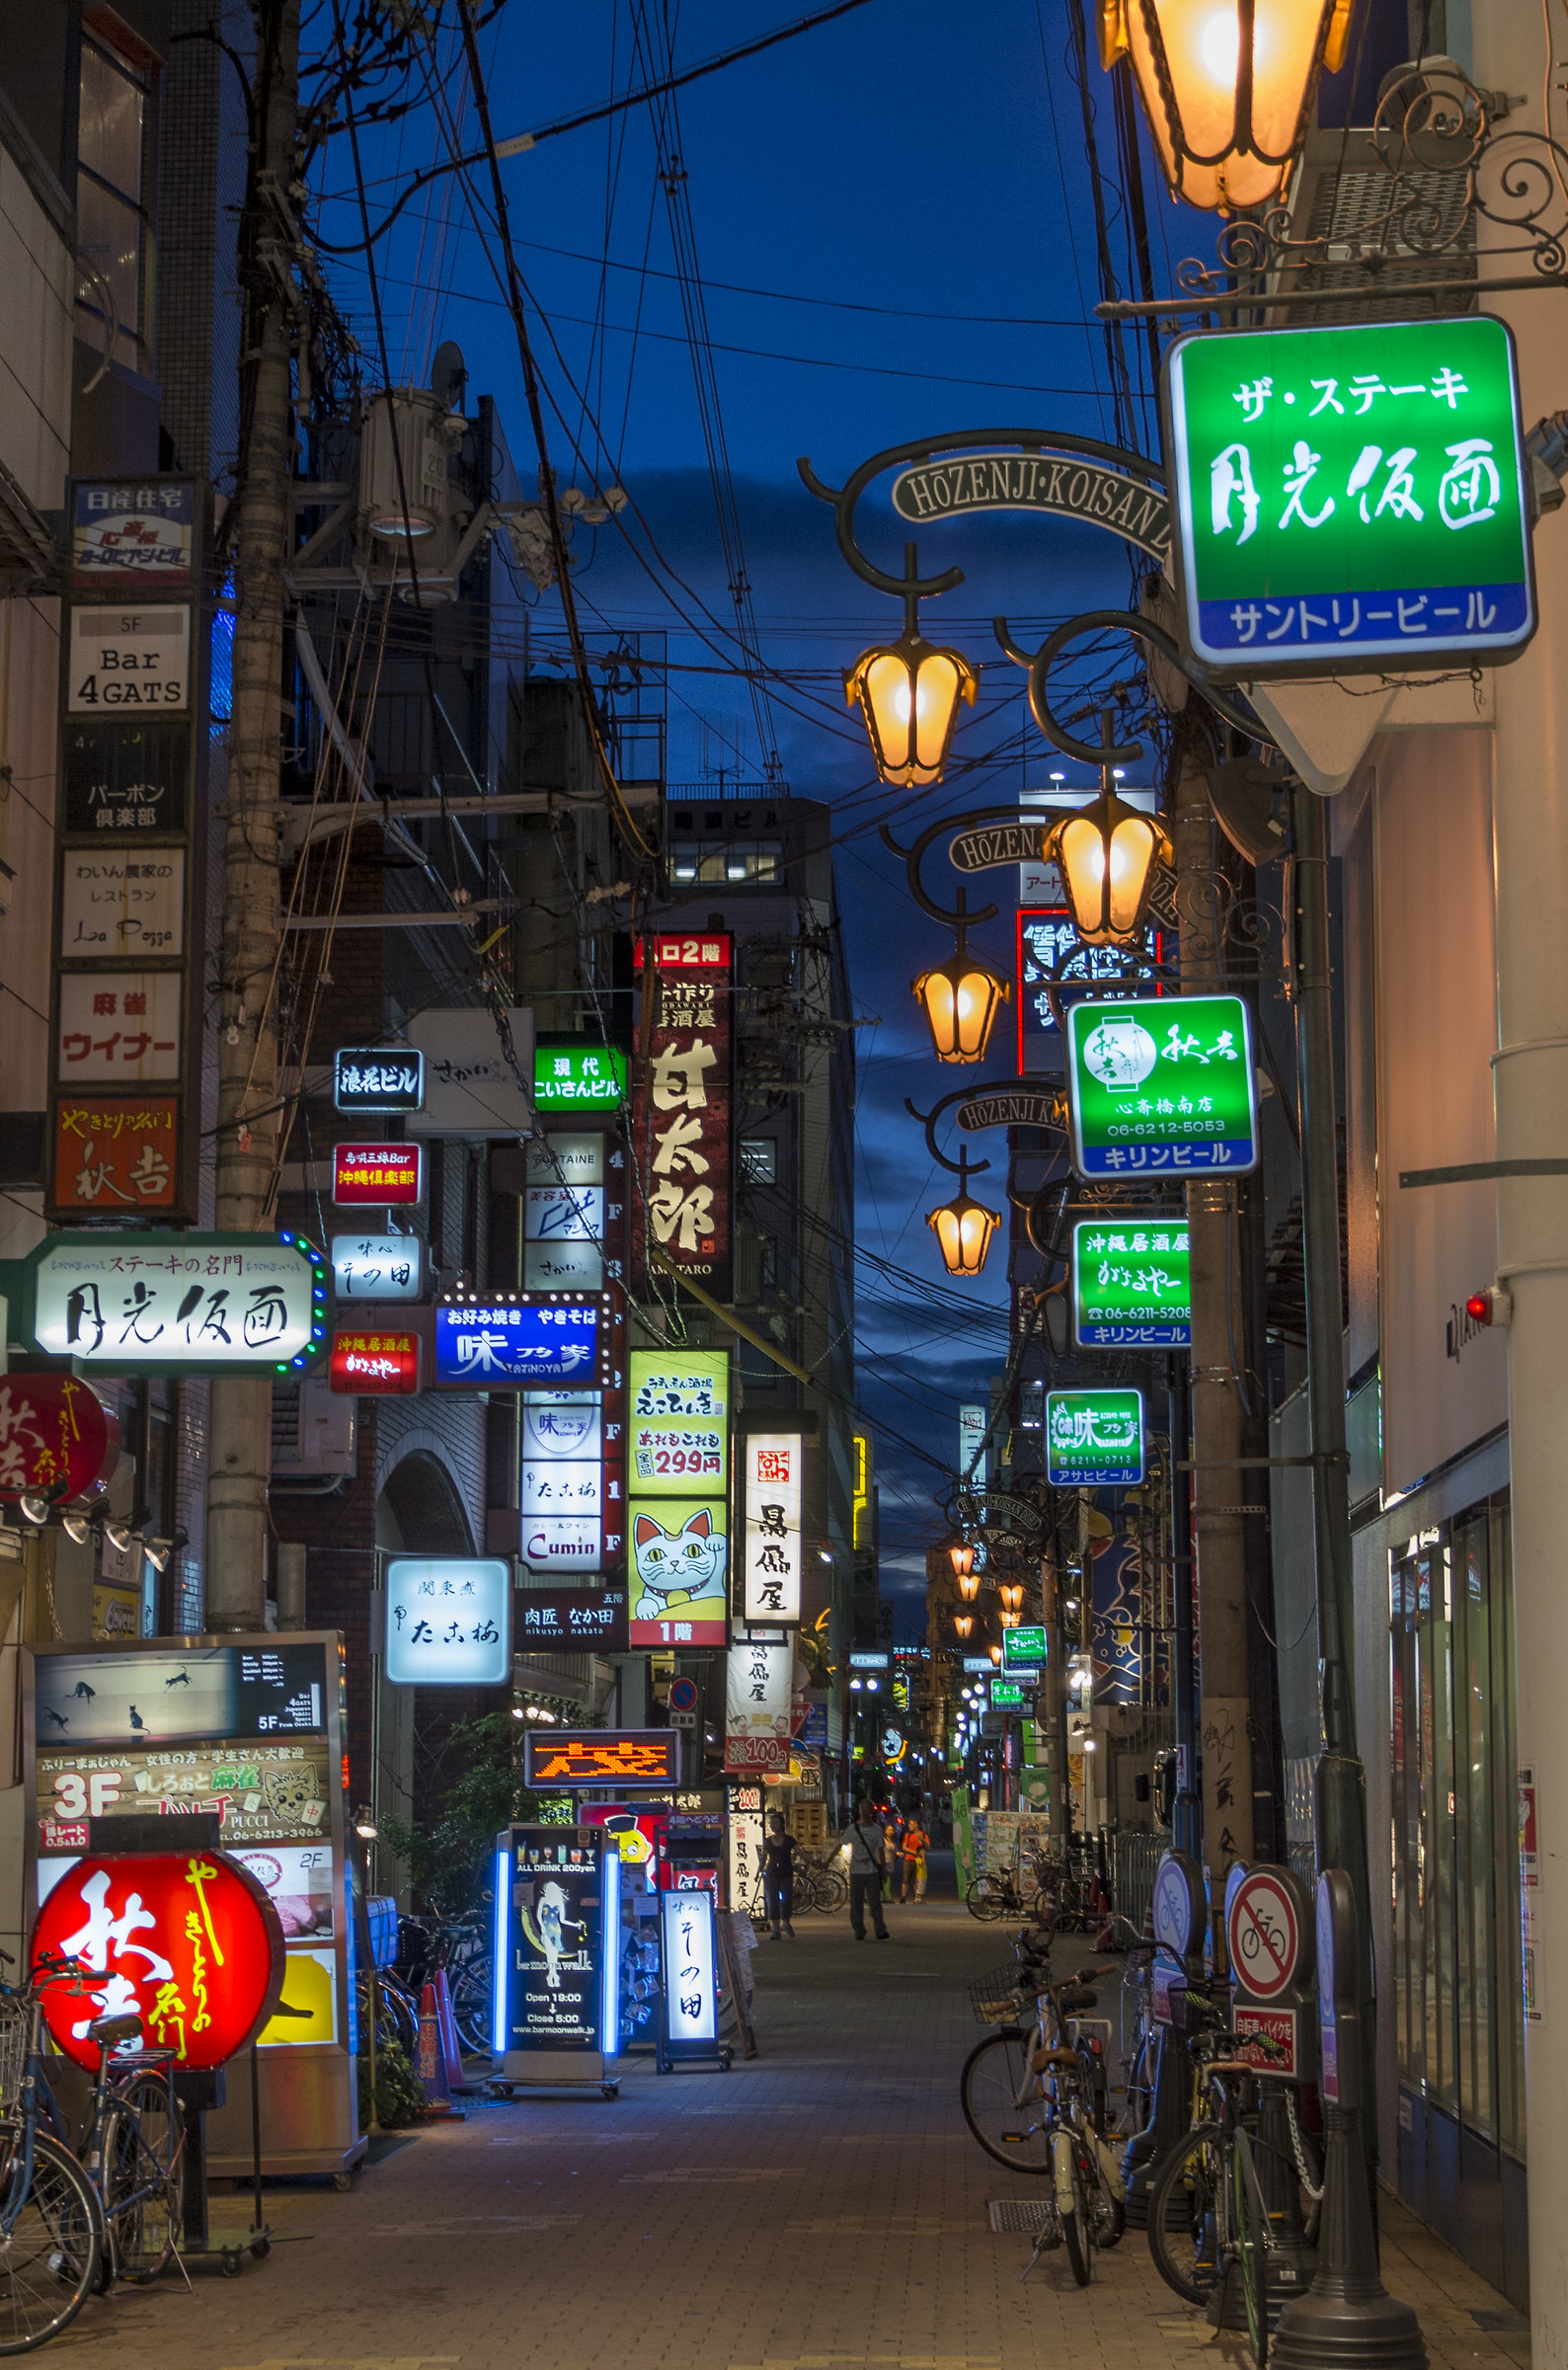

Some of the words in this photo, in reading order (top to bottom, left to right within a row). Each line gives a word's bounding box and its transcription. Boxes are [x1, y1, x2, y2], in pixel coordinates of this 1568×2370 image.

[1232, 366, 1469, 423] ザ・ステーキ
[1210, 437, 1502, 547] 月光仮面
[120, 617, 141, 632] 5F
[1229, 592, 1497, 643] サントリービール
[101, 650, 159, 671] Bar
[88, 784, 165, 805] バーボン
[76, 864, 173, 880] わいん農家の
[91, 891, 157, 904] レストラン
[73, 920, 108, 943] La
[93, 992, 147, 1016] 麻雀
[62, 1032, 176, 1063] ウイナー
[1161, 1023, 1239, 1065] 秋吉
[554, 1058, 599, 1076] 現代
[341, 1066, 420, 1094] 浪花ビル
[1107, 1119, 1225, 1137] 06-6212-5053
[648, 1038, 718, 1253] 甘太郎
[1105, 1143, 1232, 1169] キリンビール
[75, 1141, 172, 1204] 秋吉
[1086, 1232, 1190, 1253] 沖縄居酒屋
[109, 1254, 244, 1277] ステーキの名門
[650, 1264, 712, 1275] AMTARO
[65, 1281, 287, 1356] 月光仮面
[447, 1309, 522, 1326] お好み焼き
[538, 1309, 597, 1325] やきそば
[1105, 1307, 1191, 1320] 06-6211-5208
[1094, 1326, 1187, 1343] キリンビール
[339, 1337, 412, 1353] 沖縄居酒屋
[636, 1388, 713, 1416] えこひいき
[638, 1431, 720, 1447] あれもこれも
[639, 1453, 652, 1476] 全品
[655, 1450, 721, 1475] 299円
[1071, 1456, 1131, 1465] 6211-0713
[1058, 1469, 1134, 1482] アサヒビール
[527, 1533, 595, 1560] Cumin
[419, 1580, 476, 1597] 関東煮
[524, 1608, 558, 1626] 肉匠
[569, 1608, 615, 1625] なか田
[525, 1627, 564, 1637] nikusyo
[660, 1621, 693, 1641] 1階
[259, 1716, 277, 1729] 5F
[53, 1772, 122, 1819] 3F
[230, 1815, 269, 1828] PUCCI
[220, 1828, 323, 1841] EL.06-6213-3966
[300, 1853, 324, 1867] 2F
[562, 1864, 595, 1873] 200yen
[526, 1994, 549, 2003] Open
[552, 1993, 582, 2003] 19:00
[527, 2014, 554, 2023] Close
[556, 2014, 579, 2023] 5:00
[512, 2026, 595, 2035] www.barmoonwalk.jp
